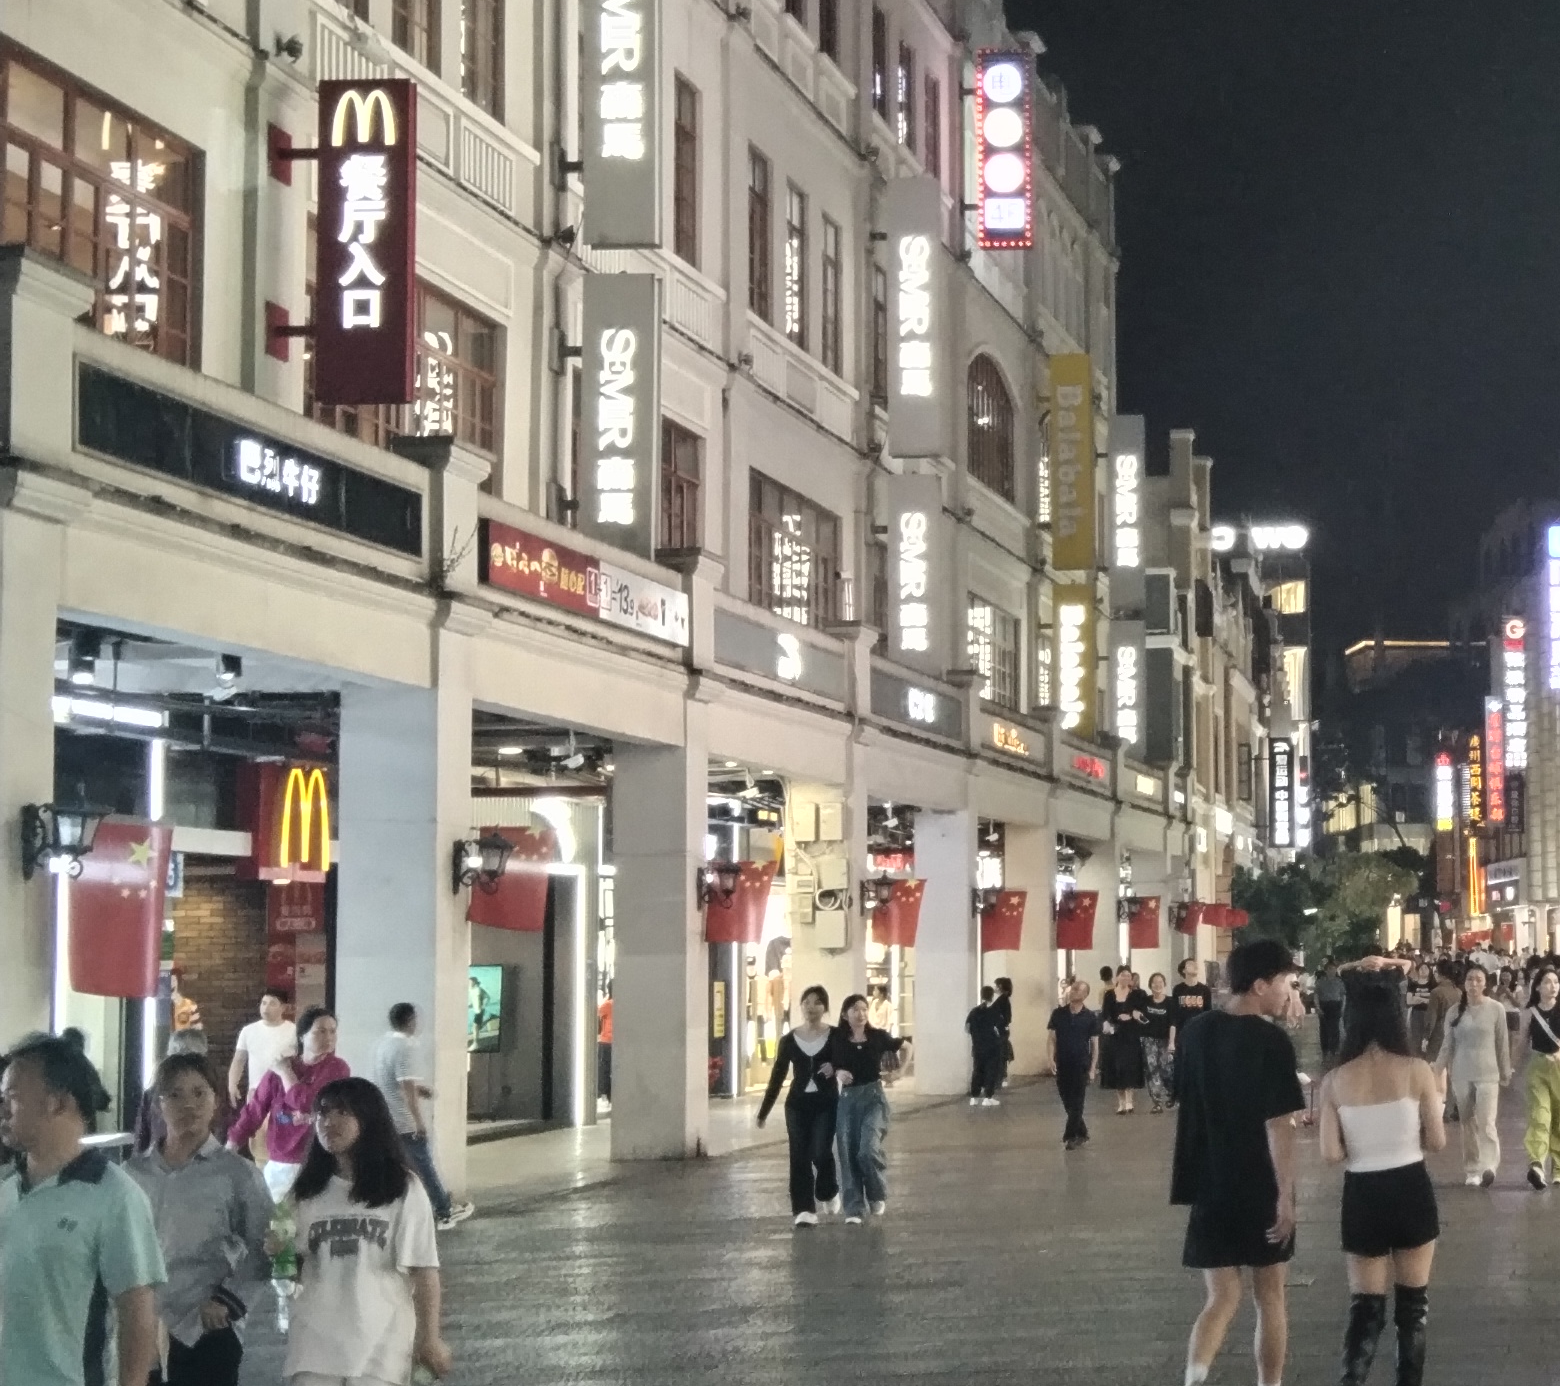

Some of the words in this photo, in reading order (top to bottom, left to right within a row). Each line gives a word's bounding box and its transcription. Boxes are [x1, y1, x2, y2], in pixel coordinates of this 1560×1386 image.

[338, 154, 387, 329] 餐厅入口
[597, 328, 636, 451] SEMIR
